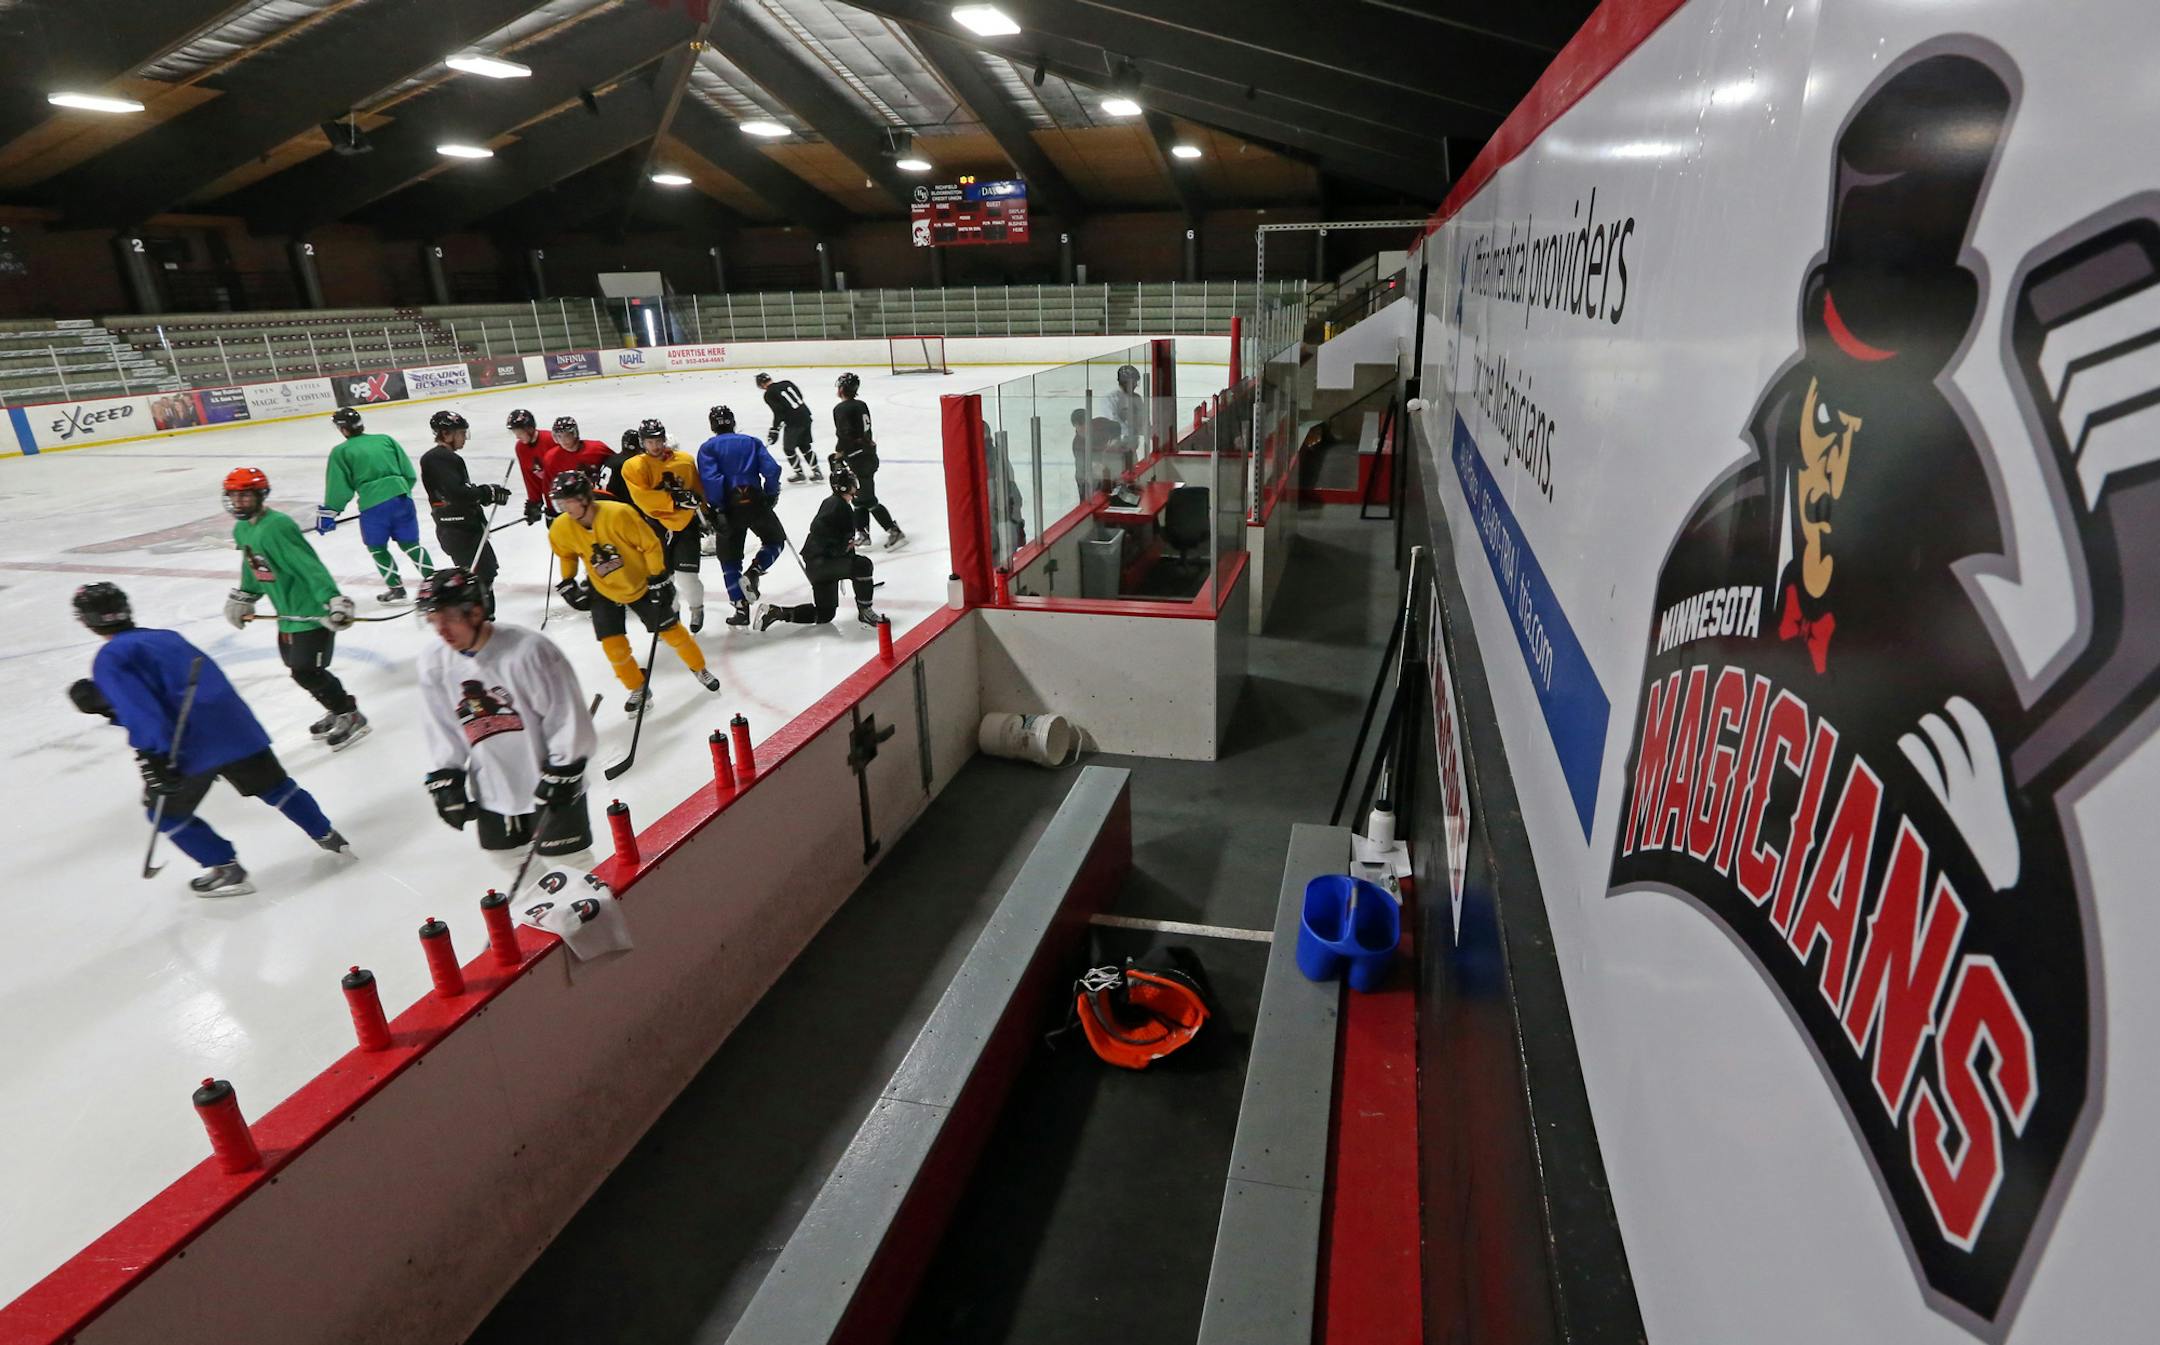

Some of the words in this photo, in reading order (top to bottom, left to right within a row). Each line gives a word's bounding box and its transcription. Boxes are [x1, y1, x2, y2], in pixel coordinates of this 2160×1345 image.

[1061, 233, 1068, 243] 5
[1188, 230, 1195, 239] 6
[132, 239, 145, 252] 2
[304, 243, 314, 255] 2
[435, 247, 443, 258] 3
[1493, 214, 1531, 303] medical
[1525, 187, 1635, 329] providers
[619, 351, 645, 366] NAHL
[668, 349, 706, 358] ADVERTISE
[707, 347, 726, 356] HERE
[349, 372, 391, 402] 93X
[251, 399, 280, 407] MAGIC
[296, 391, 332, 402] COSTUME
[781, 386, 804, 409] 11
[51, 403, 134, 441] EXCEED
[1493, 355, 1555, 503] Magicians.
[1656, 586, 1763, 656] MINNESOTA
[1519, 572, 1553, 691] tria.com
[1622, 664, 2039, 1254] MAGICIANS
